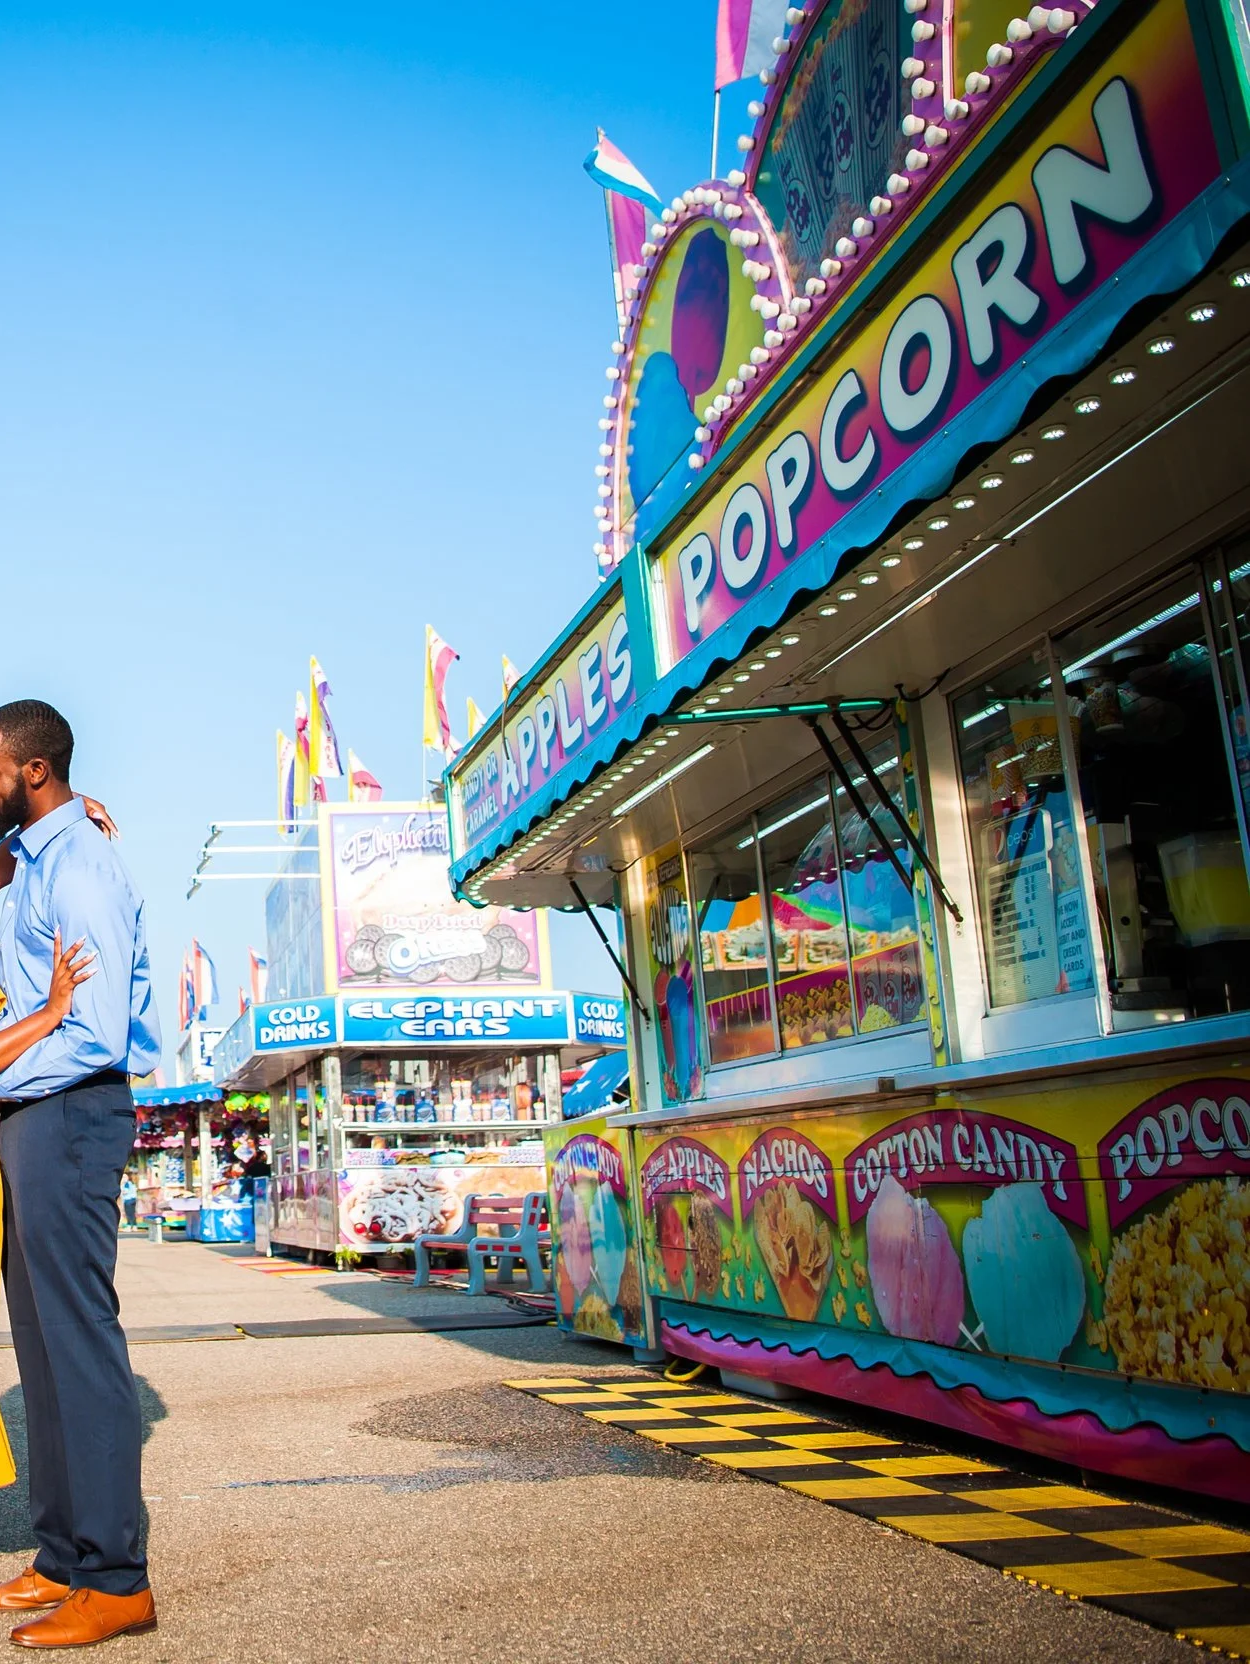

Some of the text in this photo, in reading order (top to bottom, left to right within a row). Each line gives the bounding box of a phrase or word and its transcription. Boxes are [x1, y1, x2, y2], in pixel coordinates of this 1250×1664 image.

[677, 75, 1155, 635] POPCORN
[501, 612, 633, 806] APPLES
[486, 752, 499, 781] OR
[465, 792, 500, 837] CARAMEL
[1064, 899, 1079, 914] NOW
[385, 912, 483, 934] Deep Fried
[1060, 915, 1078, 930] ACCEPT
[1072, 928, 1086, 942] AND
[1063, 944, 1082, 960] CREDIT
[1064, 959, 1085, 974] CARDS
[267, 1003, 321, 1025] COLD
[347, 999, 561, 1020] ELEPHANT
[582, 1001, 618, 1021] COLD
[259, 1020, 331, 1044] DRINKS
[400, 1017, 511, 1038] EARS
[578, 1020, 625, 1040] DRINKS
[744, 1138, 828, 1201] NACHOS
[853, 1121, 1068, 1204] COTTON CANDY
[666, 1147, 725, 1201] APPLES
